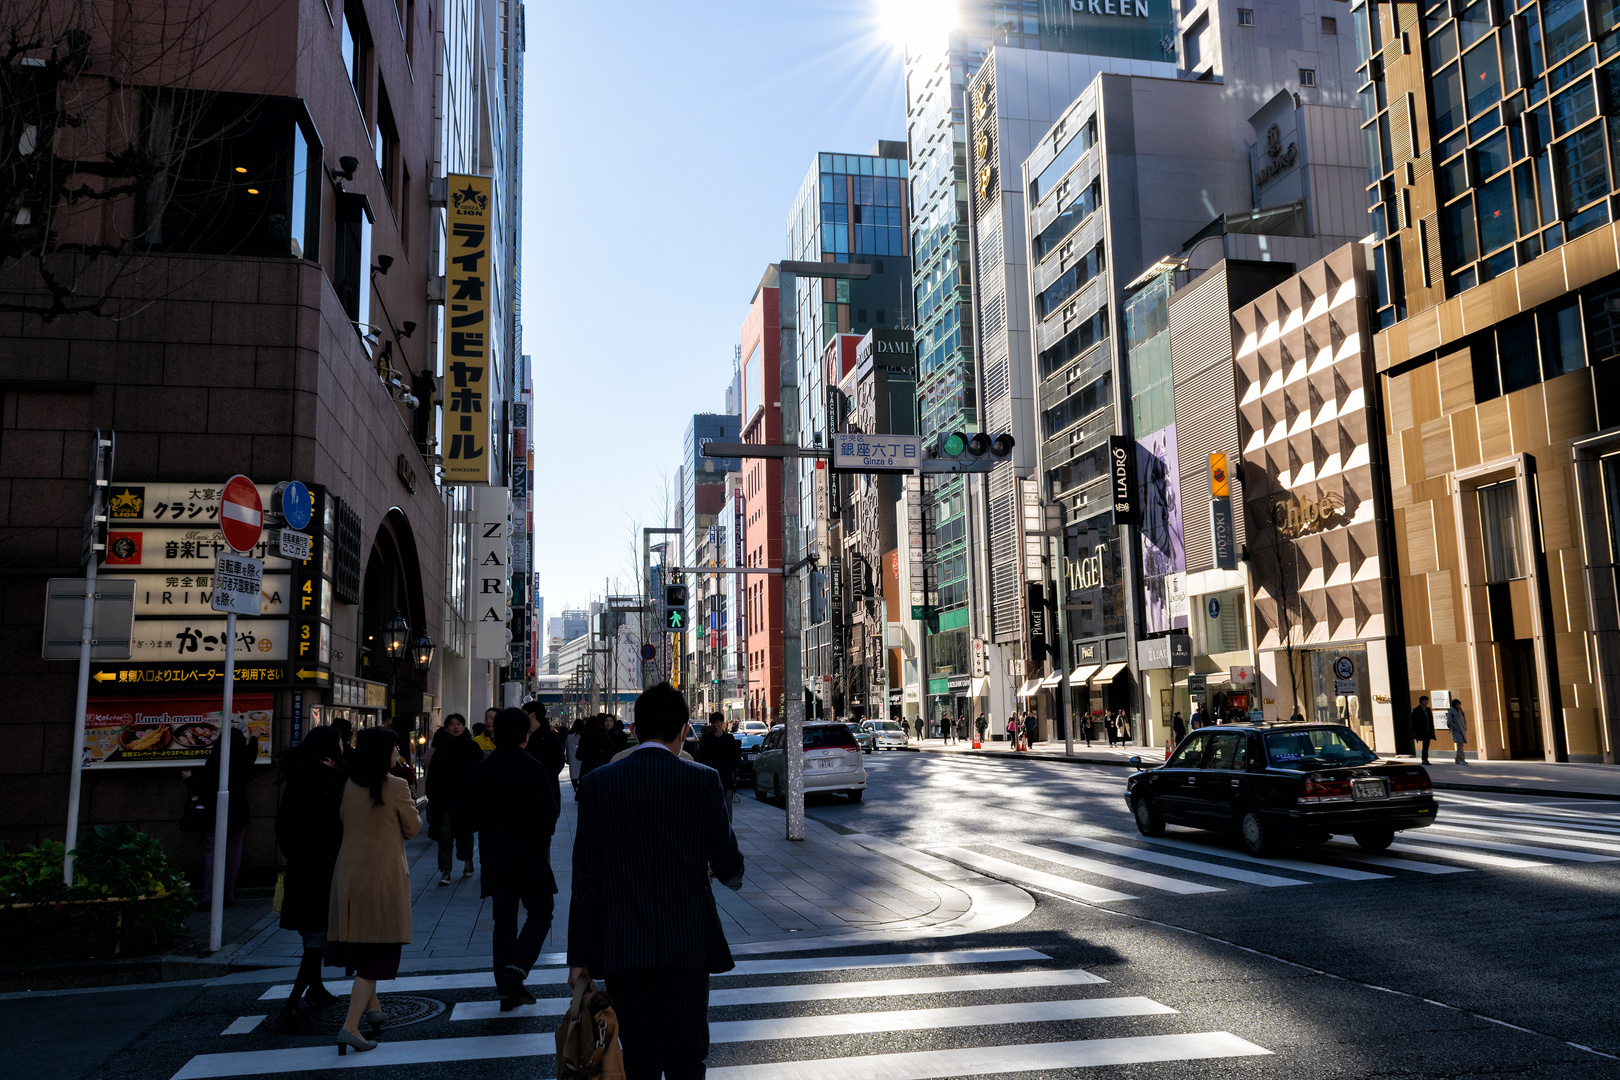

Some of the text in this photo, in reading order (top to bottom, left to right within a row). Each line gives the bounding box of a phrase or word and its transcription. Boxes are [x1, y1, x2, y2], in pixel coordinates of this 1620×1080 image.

[1071, 0, 1149, 17] GREEN
[448, 222, 486, 460] ライオンビヤホール
[840, 442, 917, 458] 銀座六丁目
[863, 457, 894, 465] Ginza 6
[1113, 447, 1128, 498] LLADRÓ
[1276, 490, 1333, 531] Chloé
[282, 545, 308, 557] ここから
[217, 557, 261, 580] 自転車を除く
[479, 522, 505, 622] ZARA
[853, 557, 862, 597] DAMIANI
[1063, 543, 1107, 597] PIAGET
[215, 593, 235, 608] を除く
[1032, 610, 1043, 636] PIAGET
[119, 668, 285, 683] 東側入口よりエレベーターご利用下さい
[135, 713, 171, 724] Lunch
[172, 715, 203, 724] menu
